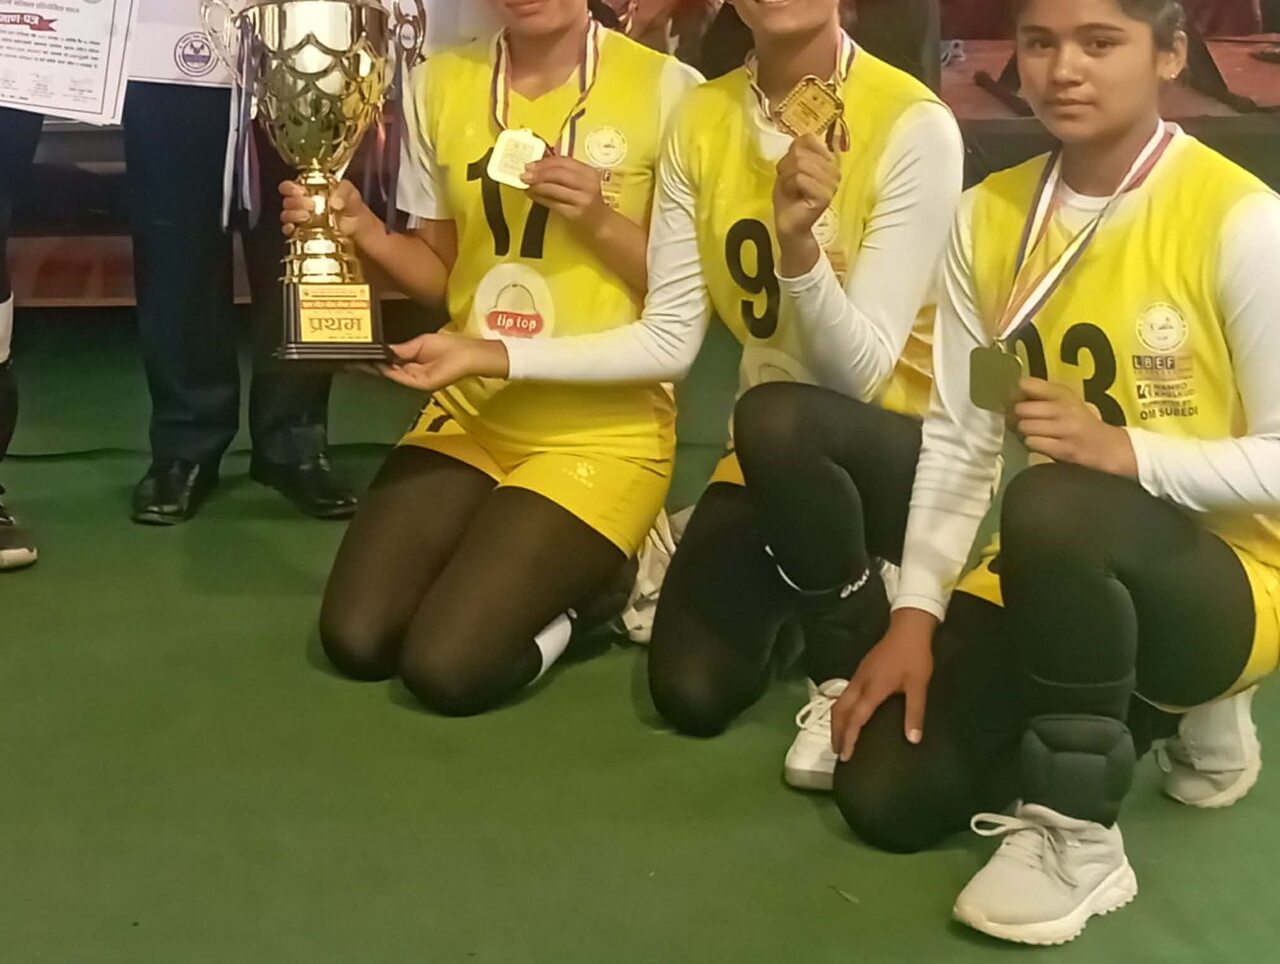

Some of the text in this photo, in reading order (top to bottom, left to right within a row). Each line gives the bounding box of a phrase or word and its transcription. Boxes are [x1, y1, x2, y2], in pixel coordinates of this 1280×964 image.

[725, 217, 781, 339] 9
[308, 317, 362, 333] प्रथम
[496, 313, 537, 331] tip top
